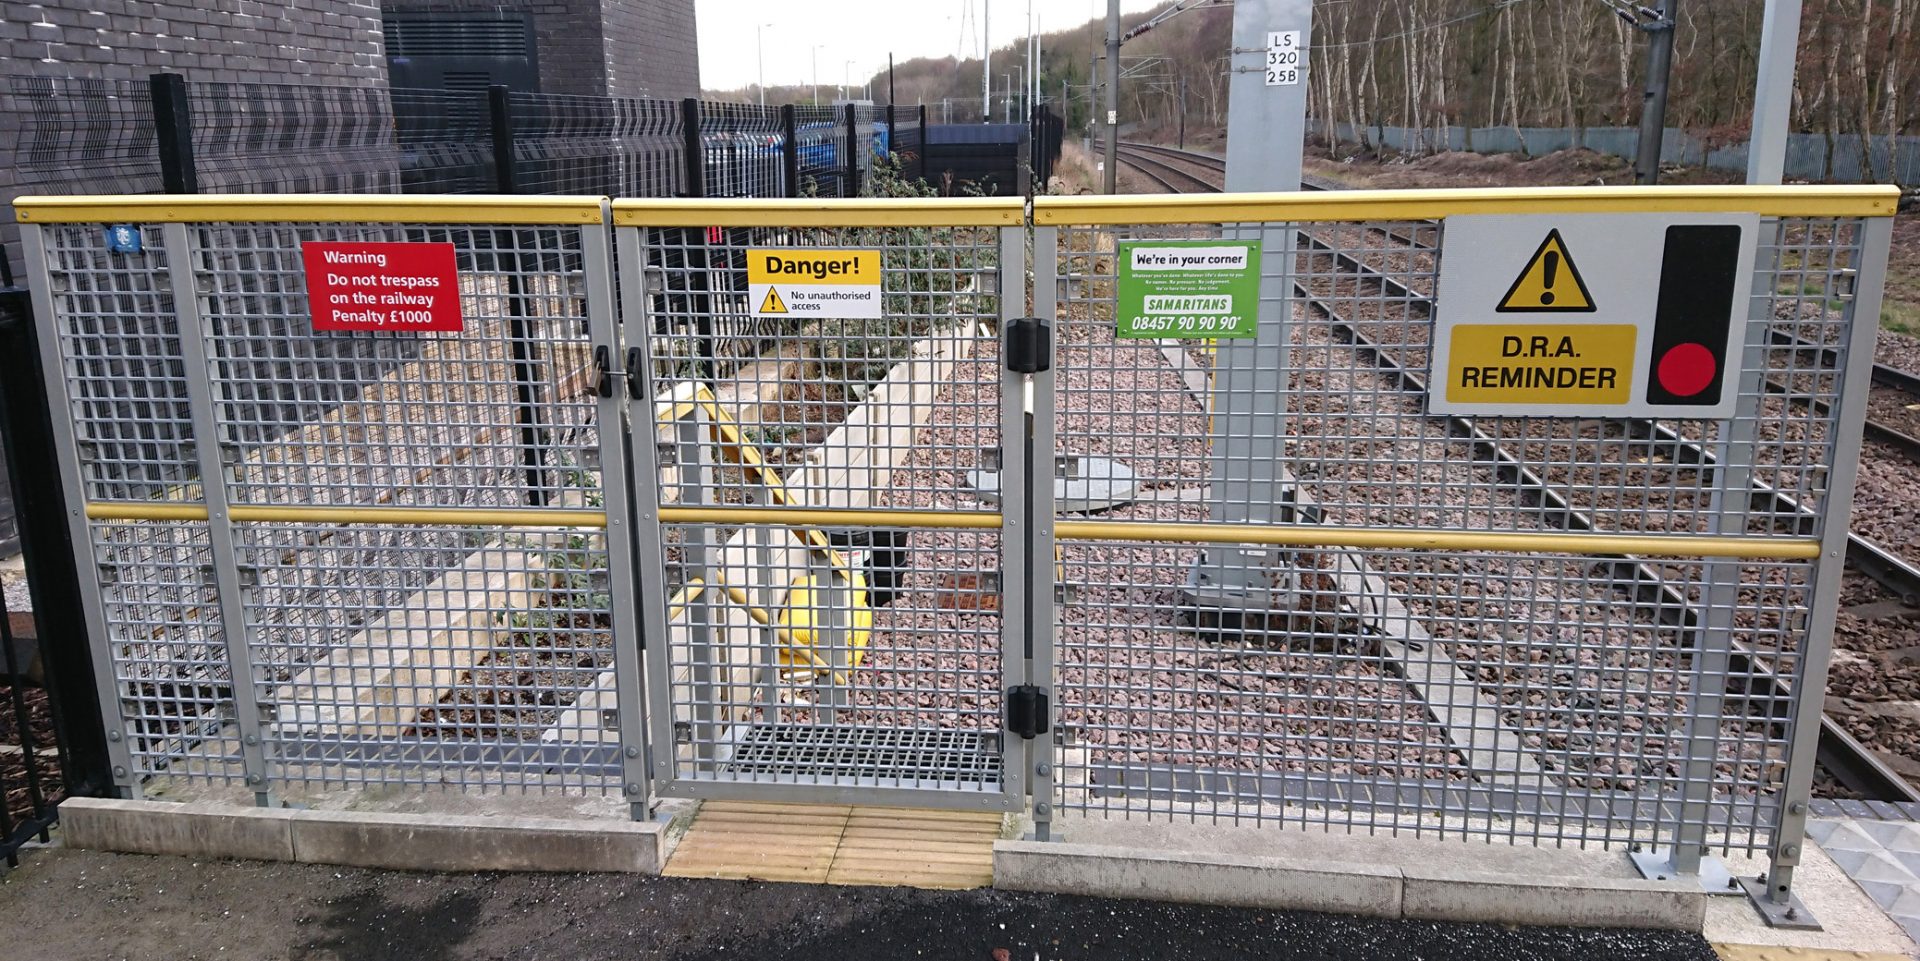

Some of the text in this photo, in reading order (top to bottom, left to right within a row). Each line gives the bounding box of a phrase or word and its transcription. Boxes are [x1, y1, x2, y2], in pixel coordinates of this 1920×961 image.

[1275, 34, 1291, 46] LS
[1269, 52, 1296, 64] 320
[1268, 70, 1296, 82] 25B
[323, 250, 386, 266] Warning
[1136, 254, 1243, 267] We're in your corner
[766, 256, 860, 279] Danger!
[327, 273, 440, 289] Do not trespass
[330, 292, 434, 308] on the railway
[791, 291, 871, 300] No unauthorised
[1148, 299, 1228, 311] SAMARITANS
[332, 310, 432, 325] Penalty £1000
[1132, 316, 1174, 330] 08457
[1178, 316, 1195, 330] 90
[1199, 316, 1216, 330] 90
[1502, 335, 1581, 358] D.R.A.
[1462, 367, 1617, 389] REMINDER
